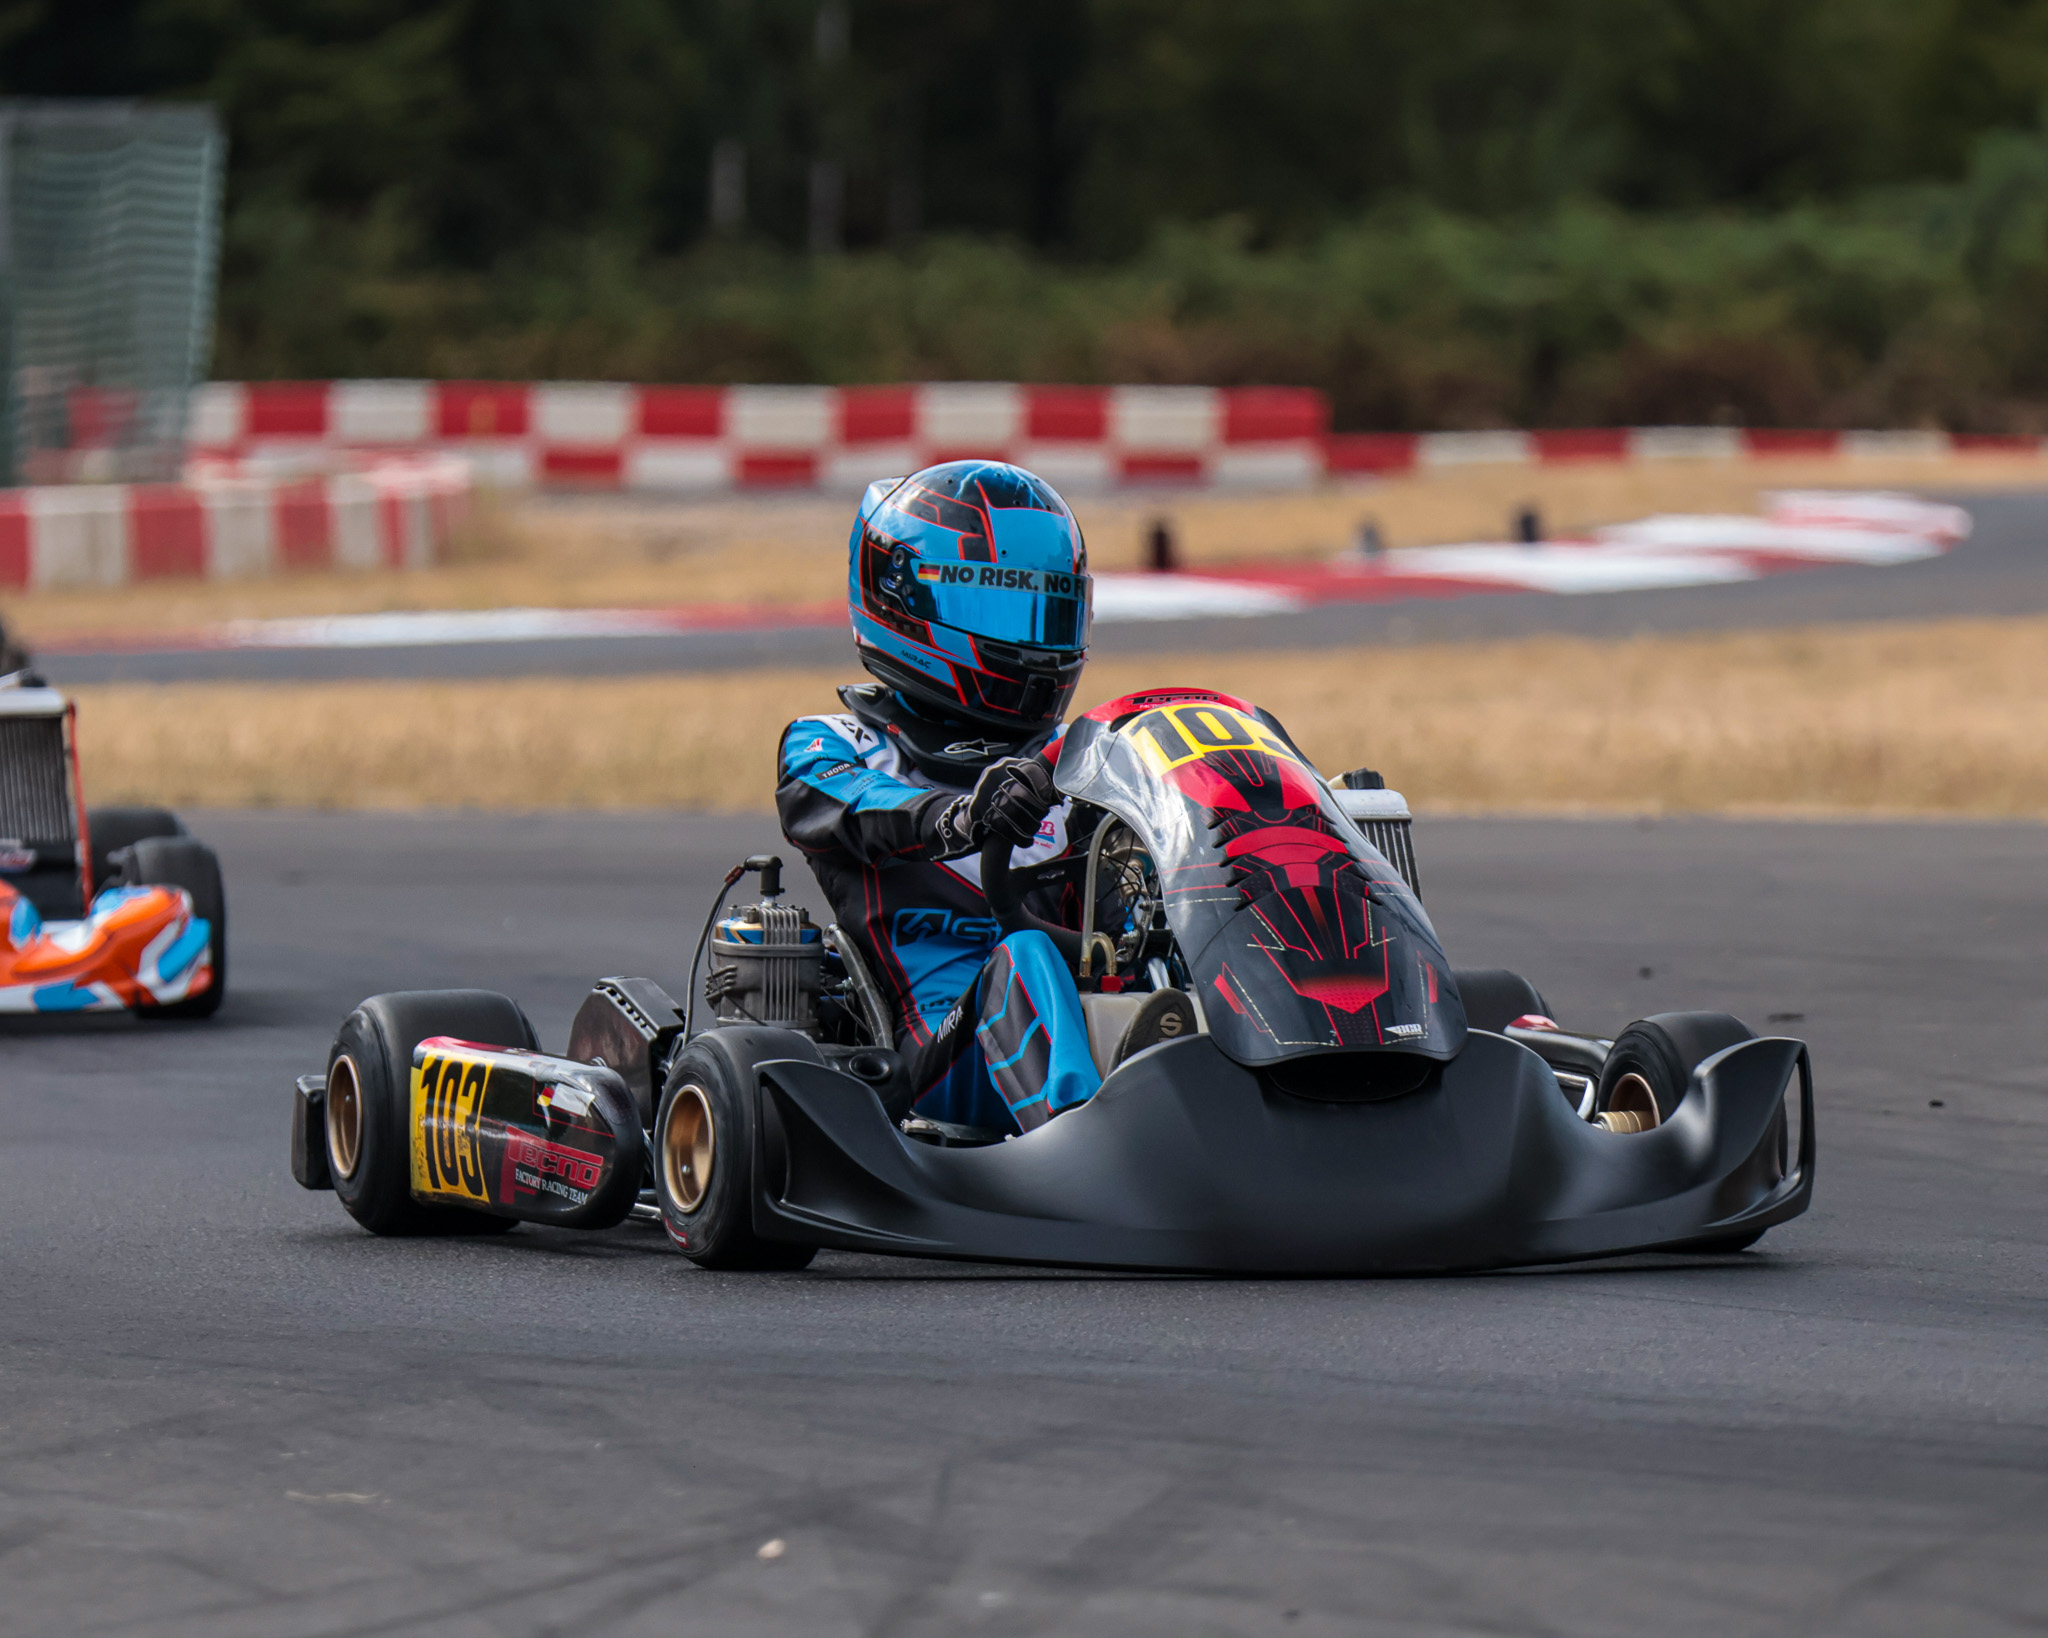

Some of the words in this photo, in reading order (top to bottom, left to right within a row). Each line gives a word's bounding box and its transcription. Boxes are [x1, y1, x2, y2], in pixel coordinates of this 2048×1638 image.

[940, 565, 974, 583] NO
[979, 567, 1039, 591] RISK.
[1044, 574, 1071, 593] NO
[420, 1055, 487, 1197] 103
[515, 1168, 540, 1189] FACTORY
[541, 1179, 568, 1198] RACING
[568, 1187, 588, 1205] TEAM
